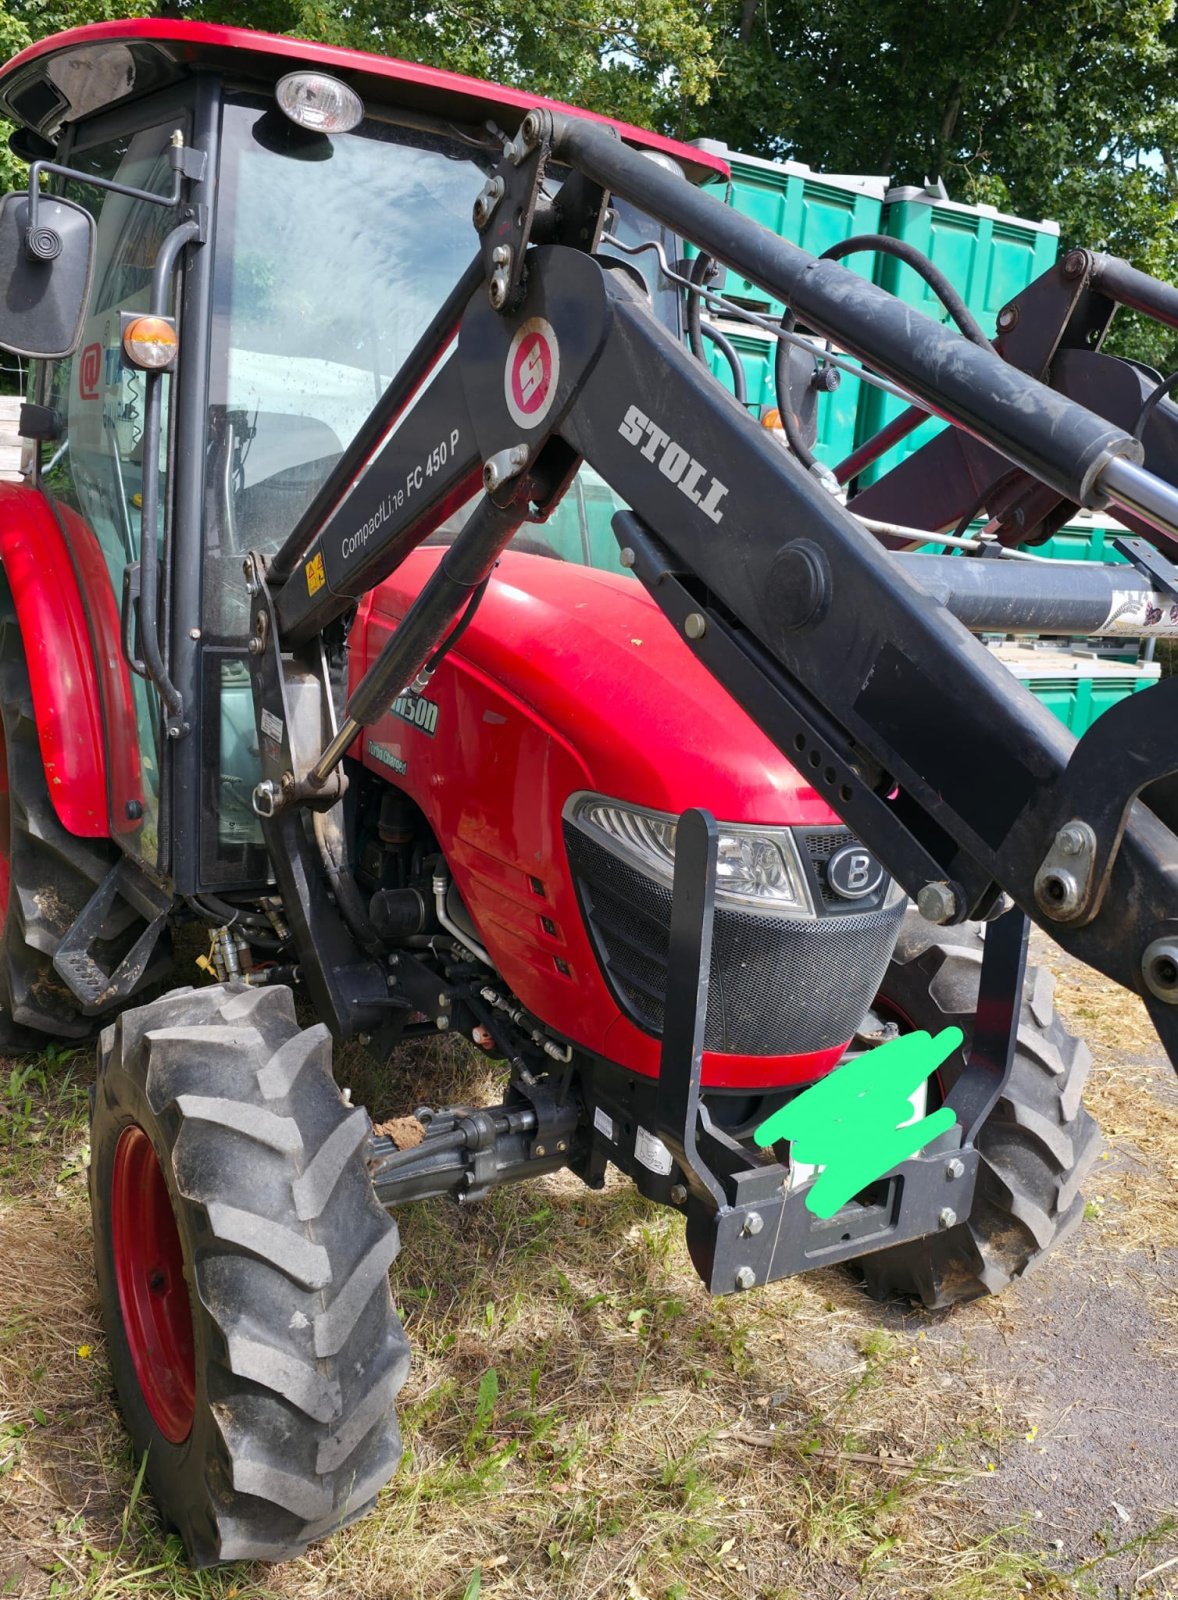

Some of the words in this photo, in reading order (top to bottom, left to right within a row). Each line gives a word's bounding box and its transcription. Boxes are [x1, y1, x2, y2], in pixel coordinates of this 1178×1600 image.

[342, 489, 404, 558] CompactLine
[406, 465, 424, 497] FC
[426, 441, 447, 478] 450
[450, 428, 460, 456] P
[618, 404, 730, 524] STOLL
[847, 855, 870, 889] B
